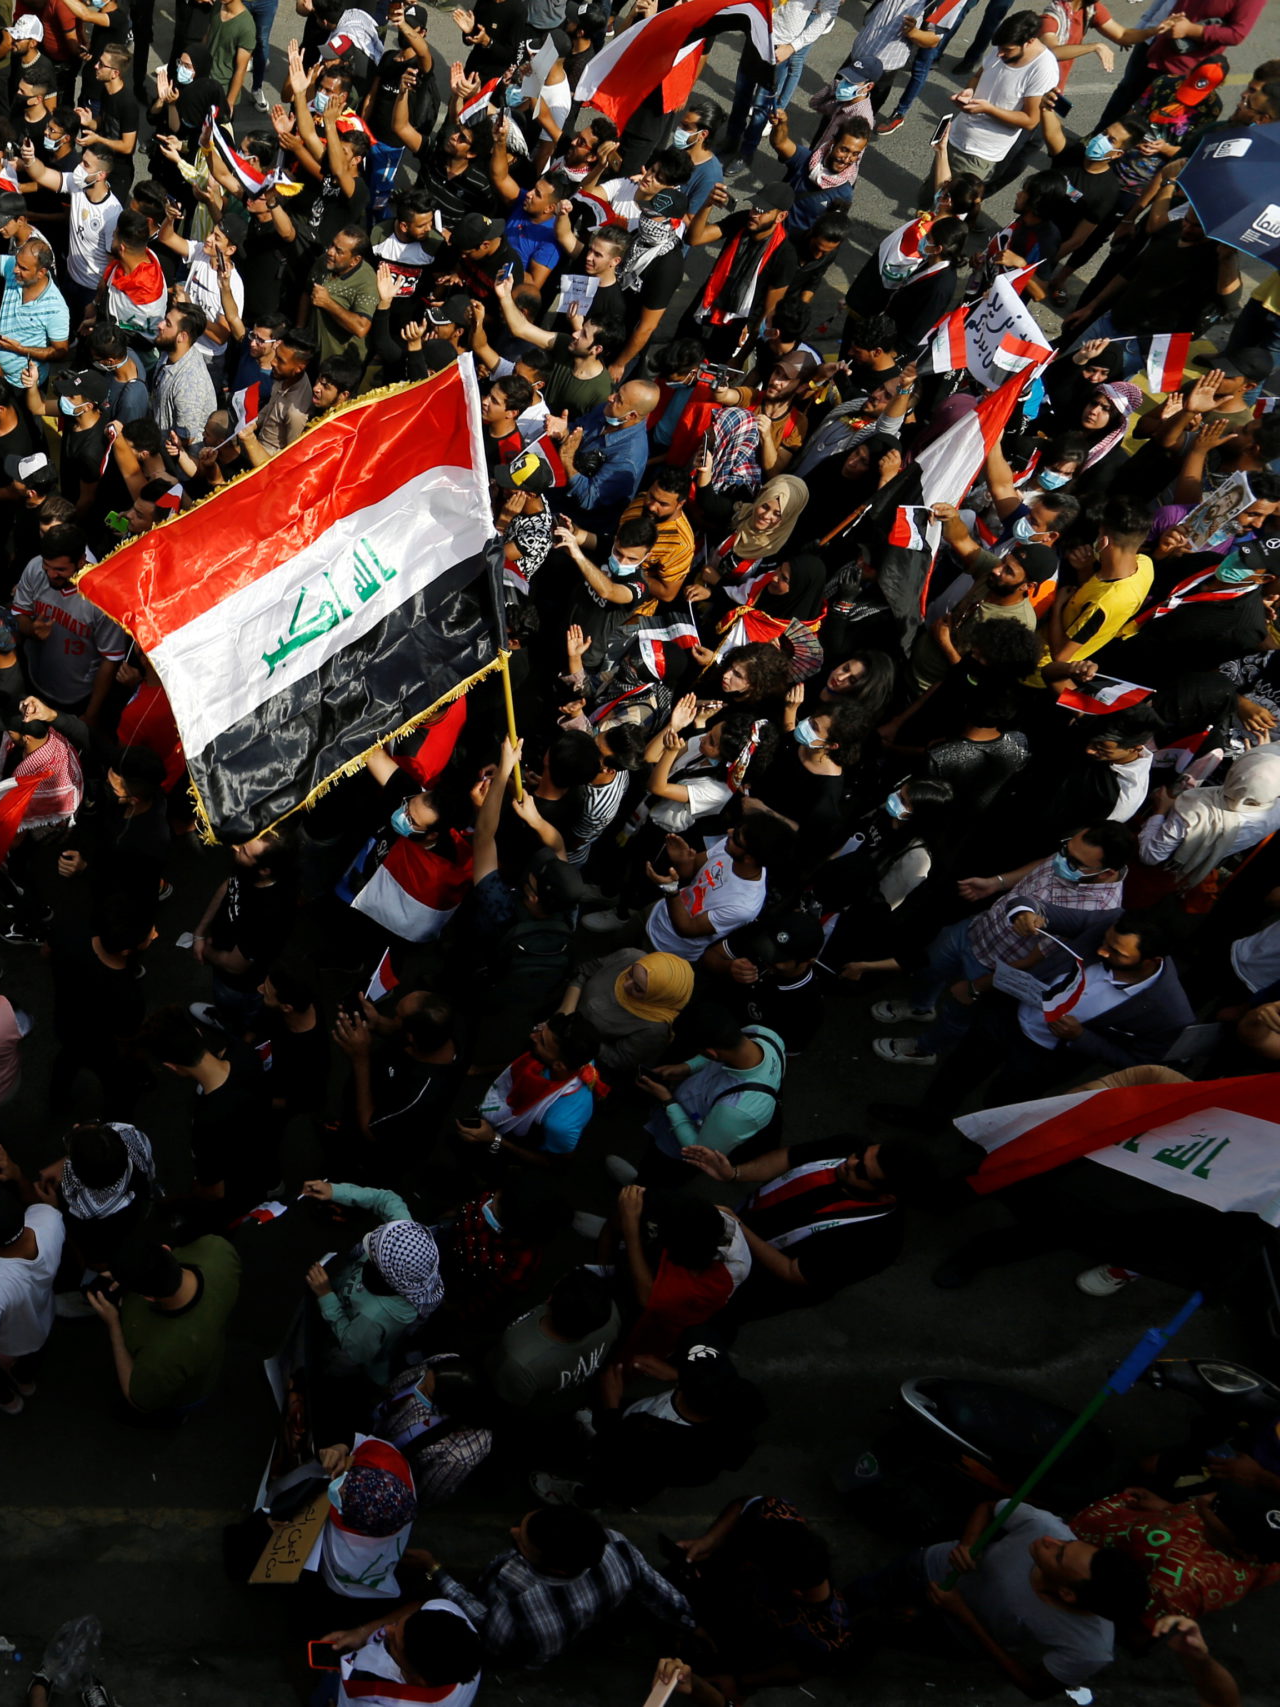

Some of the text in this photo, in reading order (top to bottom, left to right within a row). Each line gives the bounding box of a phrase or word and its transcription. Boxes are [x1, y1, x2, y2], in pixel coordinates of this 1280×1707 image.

[353, 537, 397, 603] الله
[33, 600, 93, 640] INCINNATI
[64, 638, 87, 656] 13
[1151, 1127, 1231, 1180] الله
